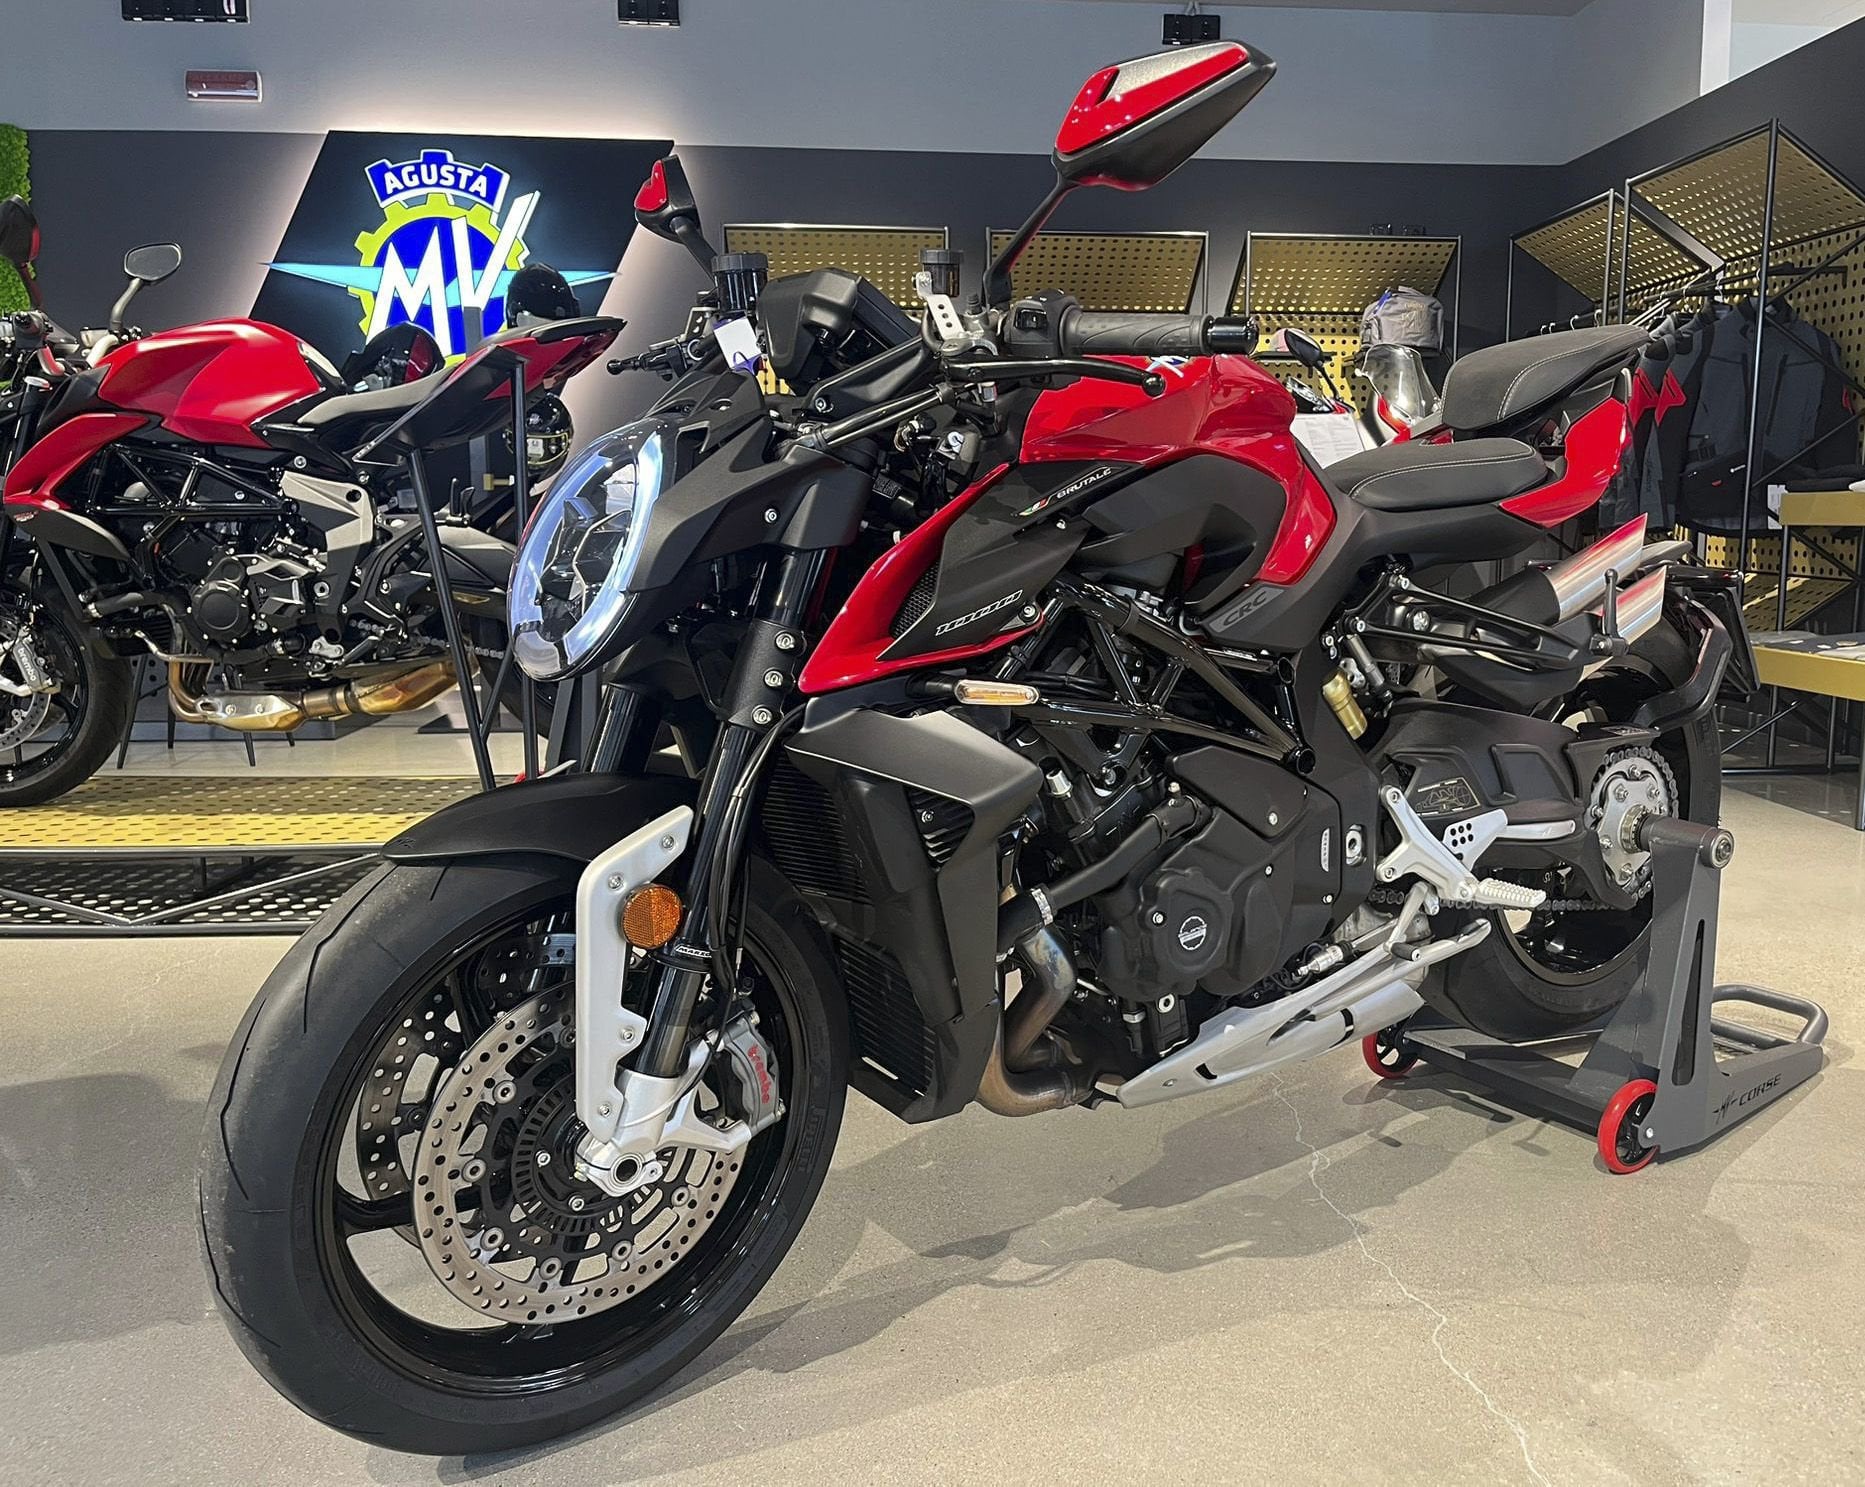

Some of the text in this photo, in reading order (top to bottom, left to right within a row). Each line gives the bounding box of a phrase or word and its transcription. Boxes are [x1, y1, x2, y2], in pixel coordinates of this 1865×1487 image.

[384, 164, 488, 198] AGUSTA
[366, 192, 537, 358] MV
[1056, 467, 1112, 499] BRUTALE
[935, 589, 1024, 637] 1000
[1223, 591, 1267, 626] CRC
[17, 647, 37, 682] brembo
[1738, 1073, 1782, 1107] CORSE
